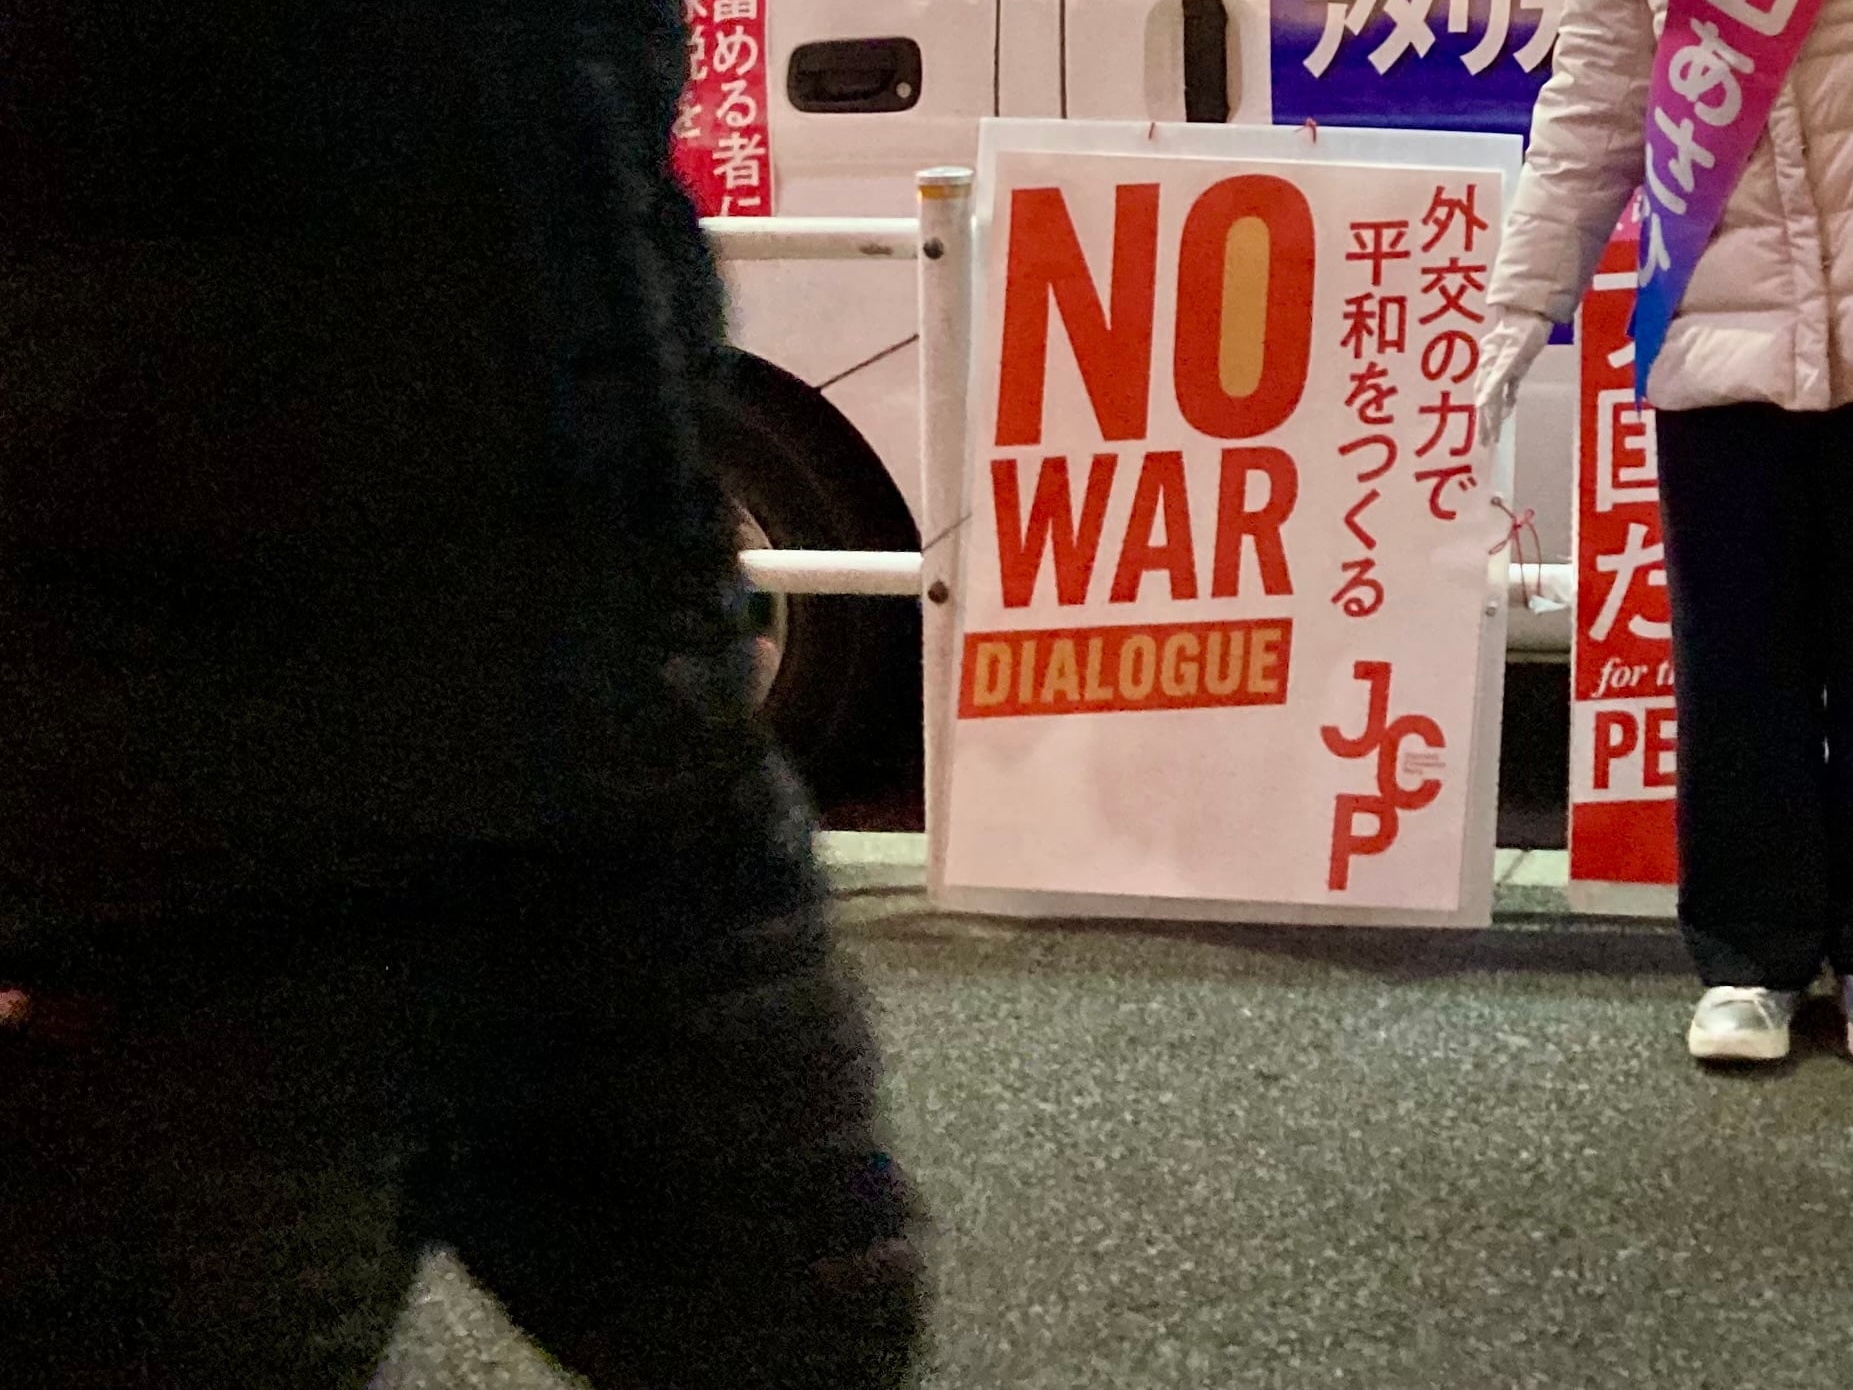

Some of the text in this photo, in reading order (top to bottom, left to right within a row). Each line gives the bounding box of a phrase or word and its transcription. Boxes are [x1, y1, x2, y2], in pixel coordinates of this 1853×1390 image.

[994, 173, 1317, 446] NO
[1330, 218, 1411, 618] 平和をつくる
[1415, 182, 1488, 521] 外交の力で
[989, 446, 1299, 609] WAR
[972, 627, 1284, 707] DIALOGUE
[1591, 657, 1649, 699] for
